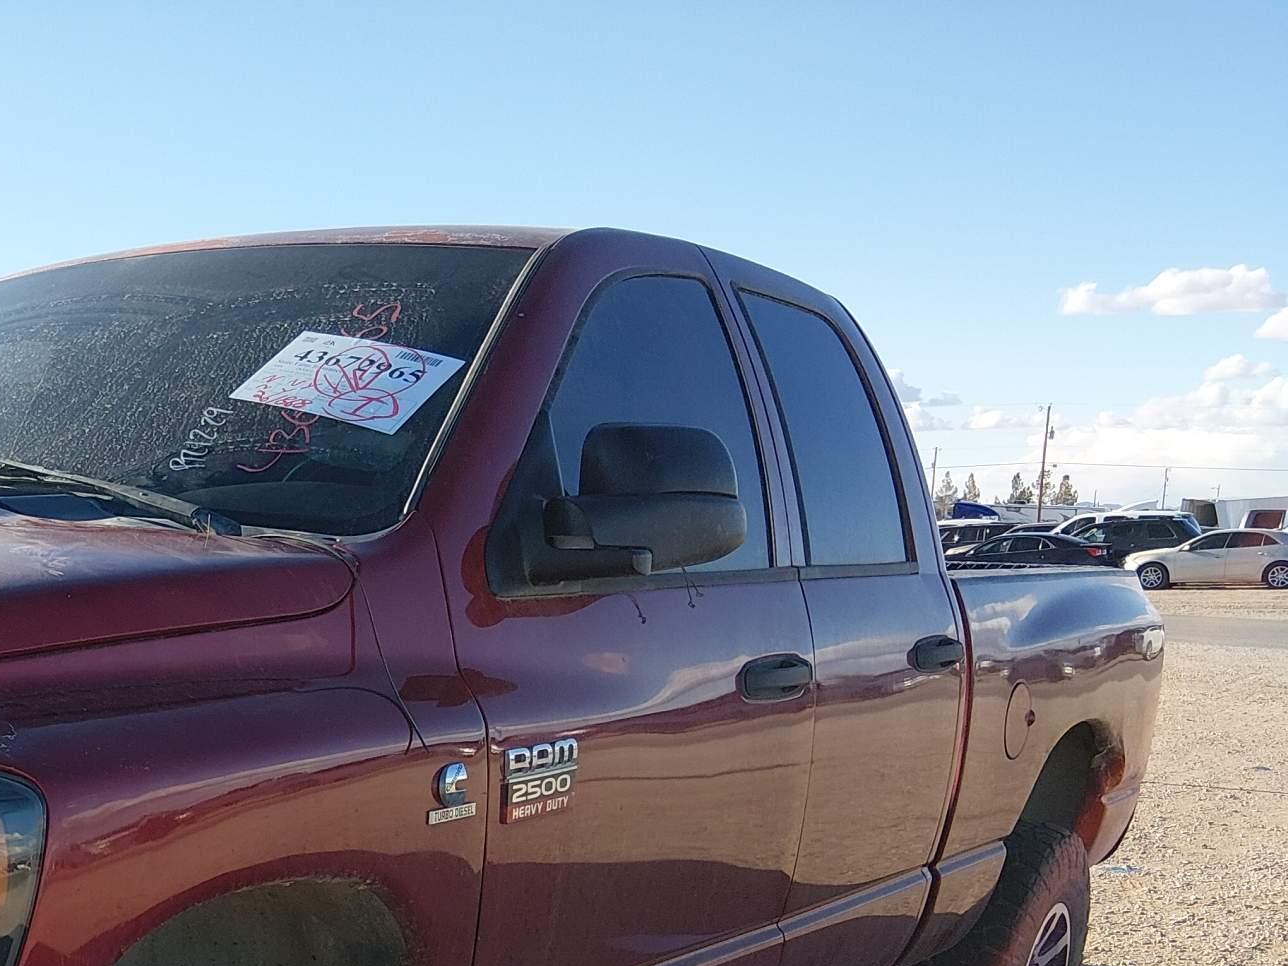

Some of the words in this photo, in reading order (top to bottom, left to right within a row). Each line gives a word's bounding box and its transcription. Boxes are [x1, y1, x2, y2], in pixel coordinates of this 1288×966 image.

[509, 738, 579, 774] RAM
[511, 774, 571, 803] 2500
[434, 809, 454, 823] TURBO
[455, 805, 474, 817] DIESEL
[512, 802, 543, 820] HEAVY
[546, 796, 569, 812] DUTY
